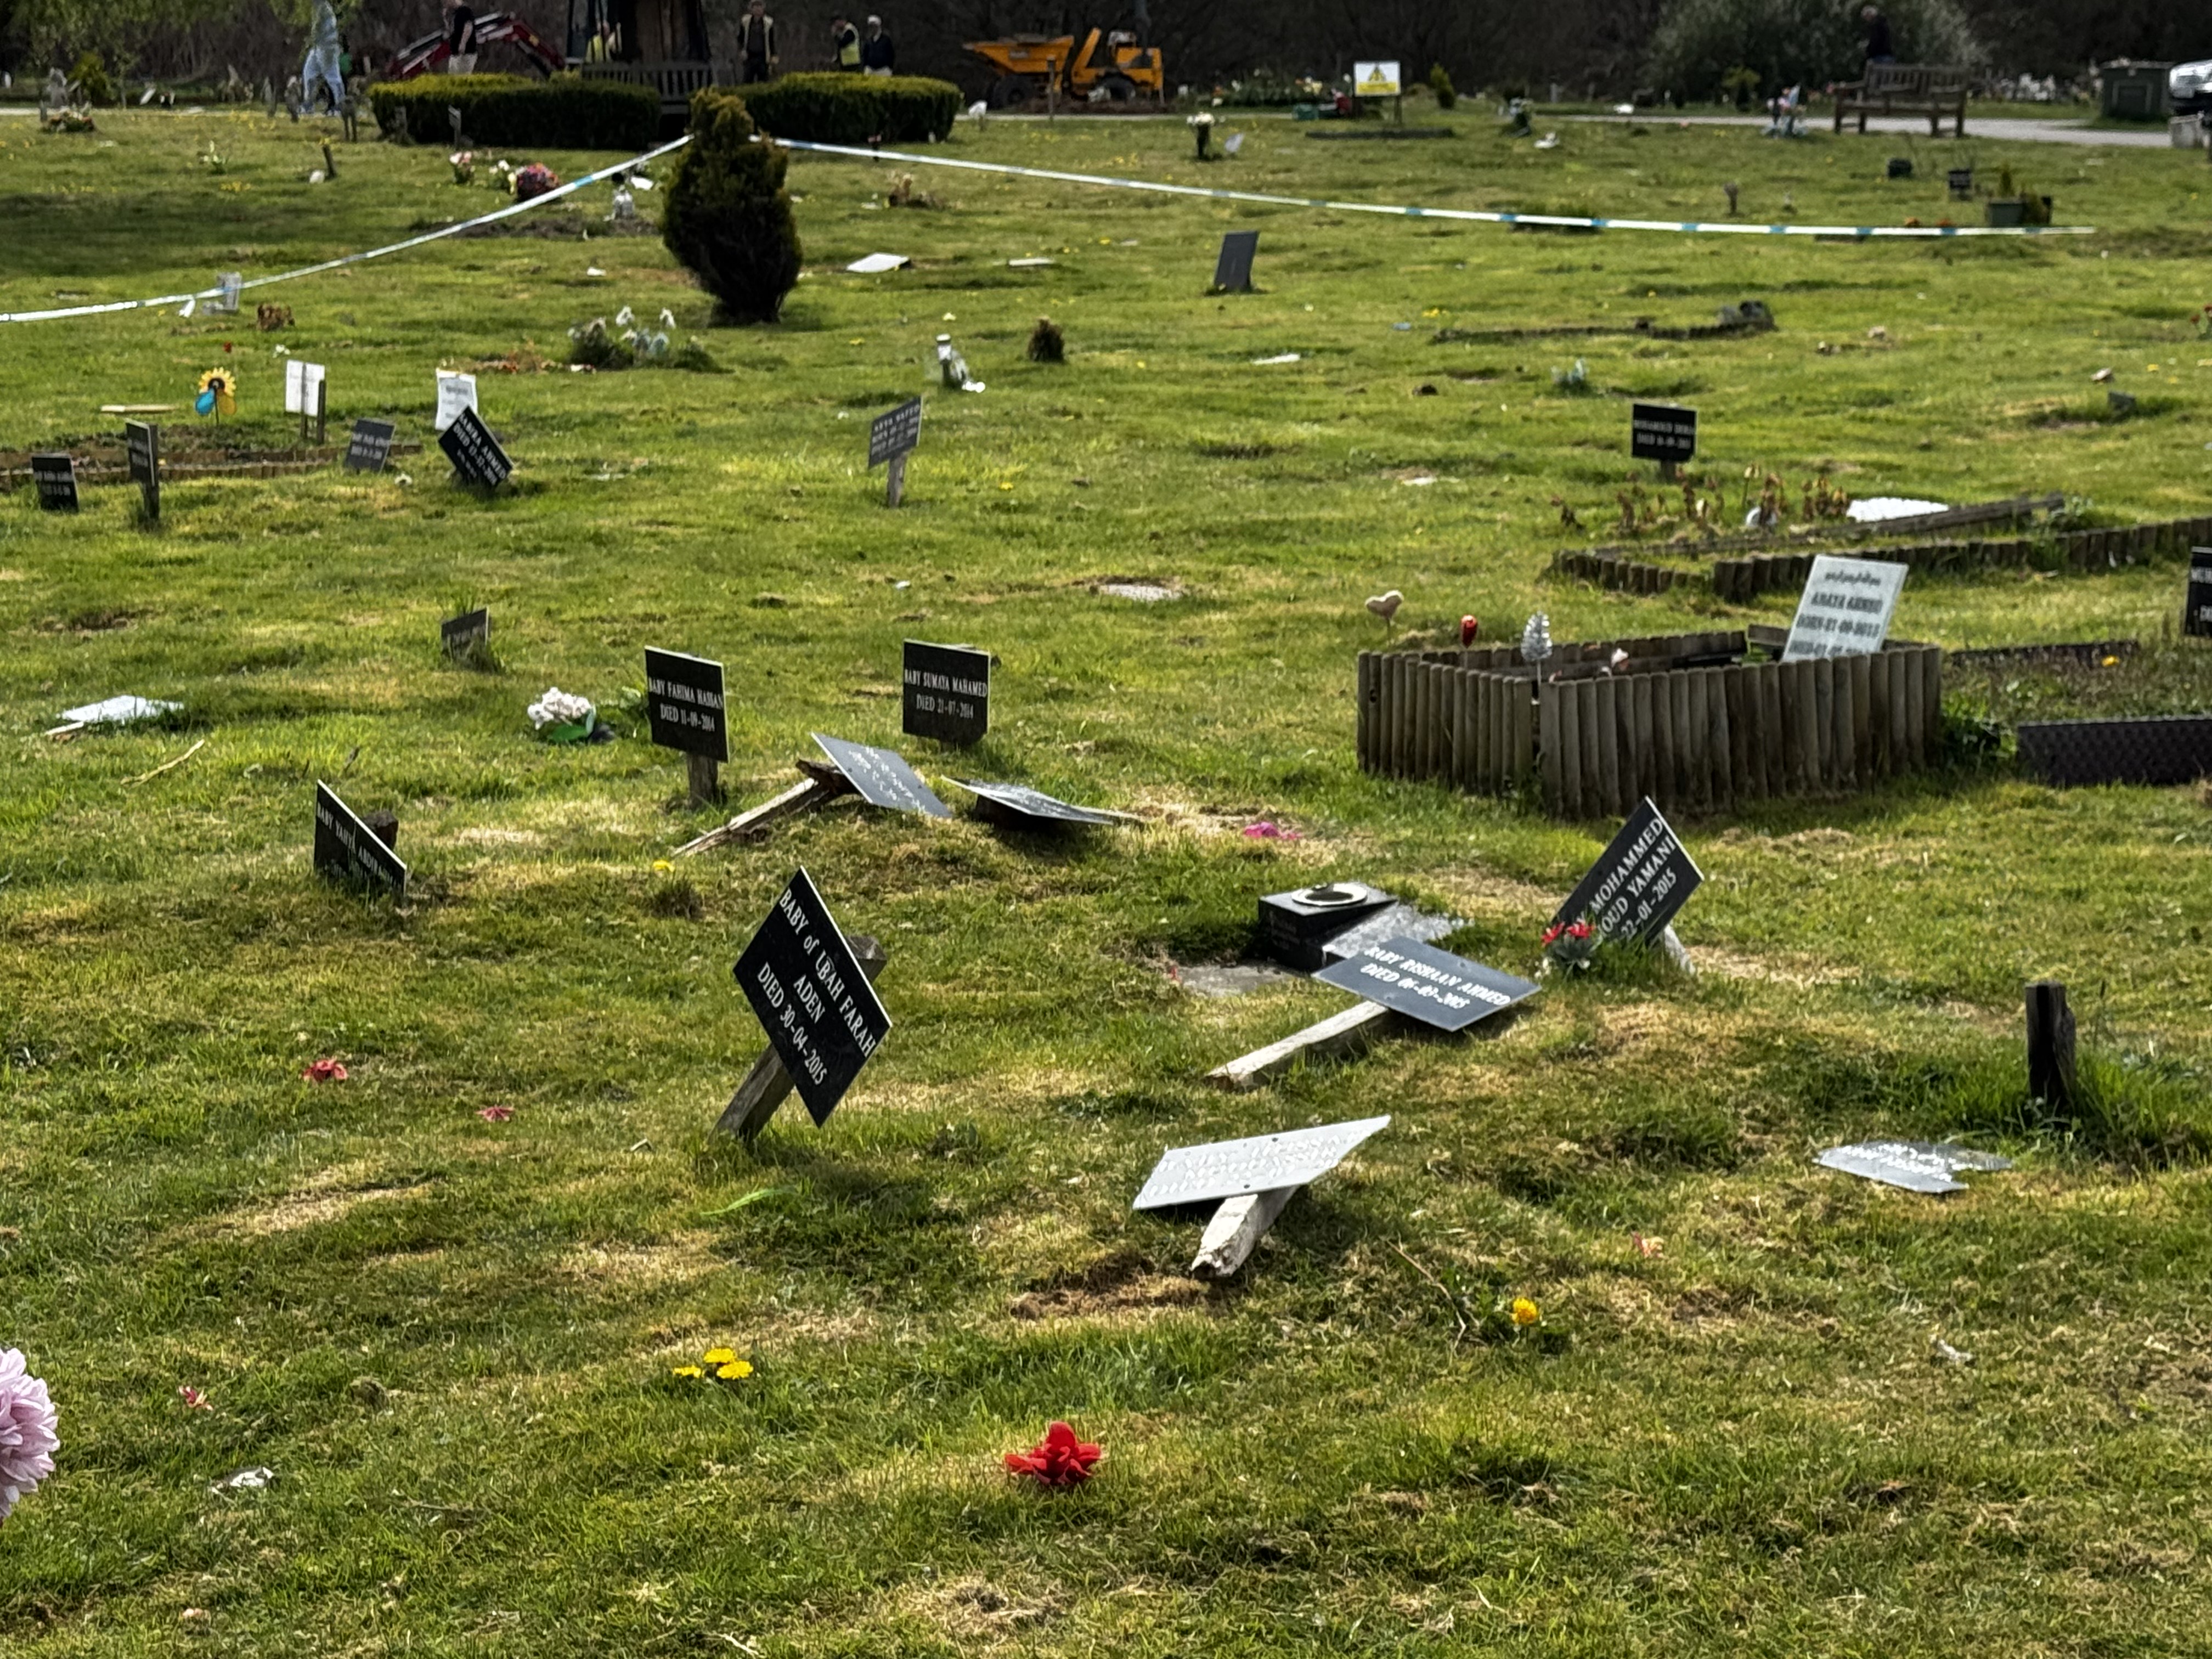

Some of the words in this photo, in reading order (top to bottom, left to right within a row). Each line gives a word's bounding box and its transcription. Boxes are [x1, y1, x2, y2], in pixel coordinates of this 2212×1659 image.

[648, 676, 665, 695] BABY
[697, 689, 723, 709] HASSAN
[905, 669, 921, 686] BABY
[952, 676, 988, 697] MAHAMED
[917, 693, 935, 712] DIED
[660, 703, 679, 723] DIED
[1589, 817, 1663, 915] MOHAMMED
[1627, 836, 1677, 898] YAMANI
[779, 887, 809, 935] BABY
[804, 935, 820, 955] of
[839, 995, 876, 1058] FARAH
[1360, 962, 1400, 983] DIED
[1364, 946, 1404, 964] BABY
[1457, 982, 1511, 1006] AHMED
[757, 962, 785, 1008] DIED
[780, 1004, 827, 1086] 30-04-2015
[793, 974, 826, 1024] ADEN
